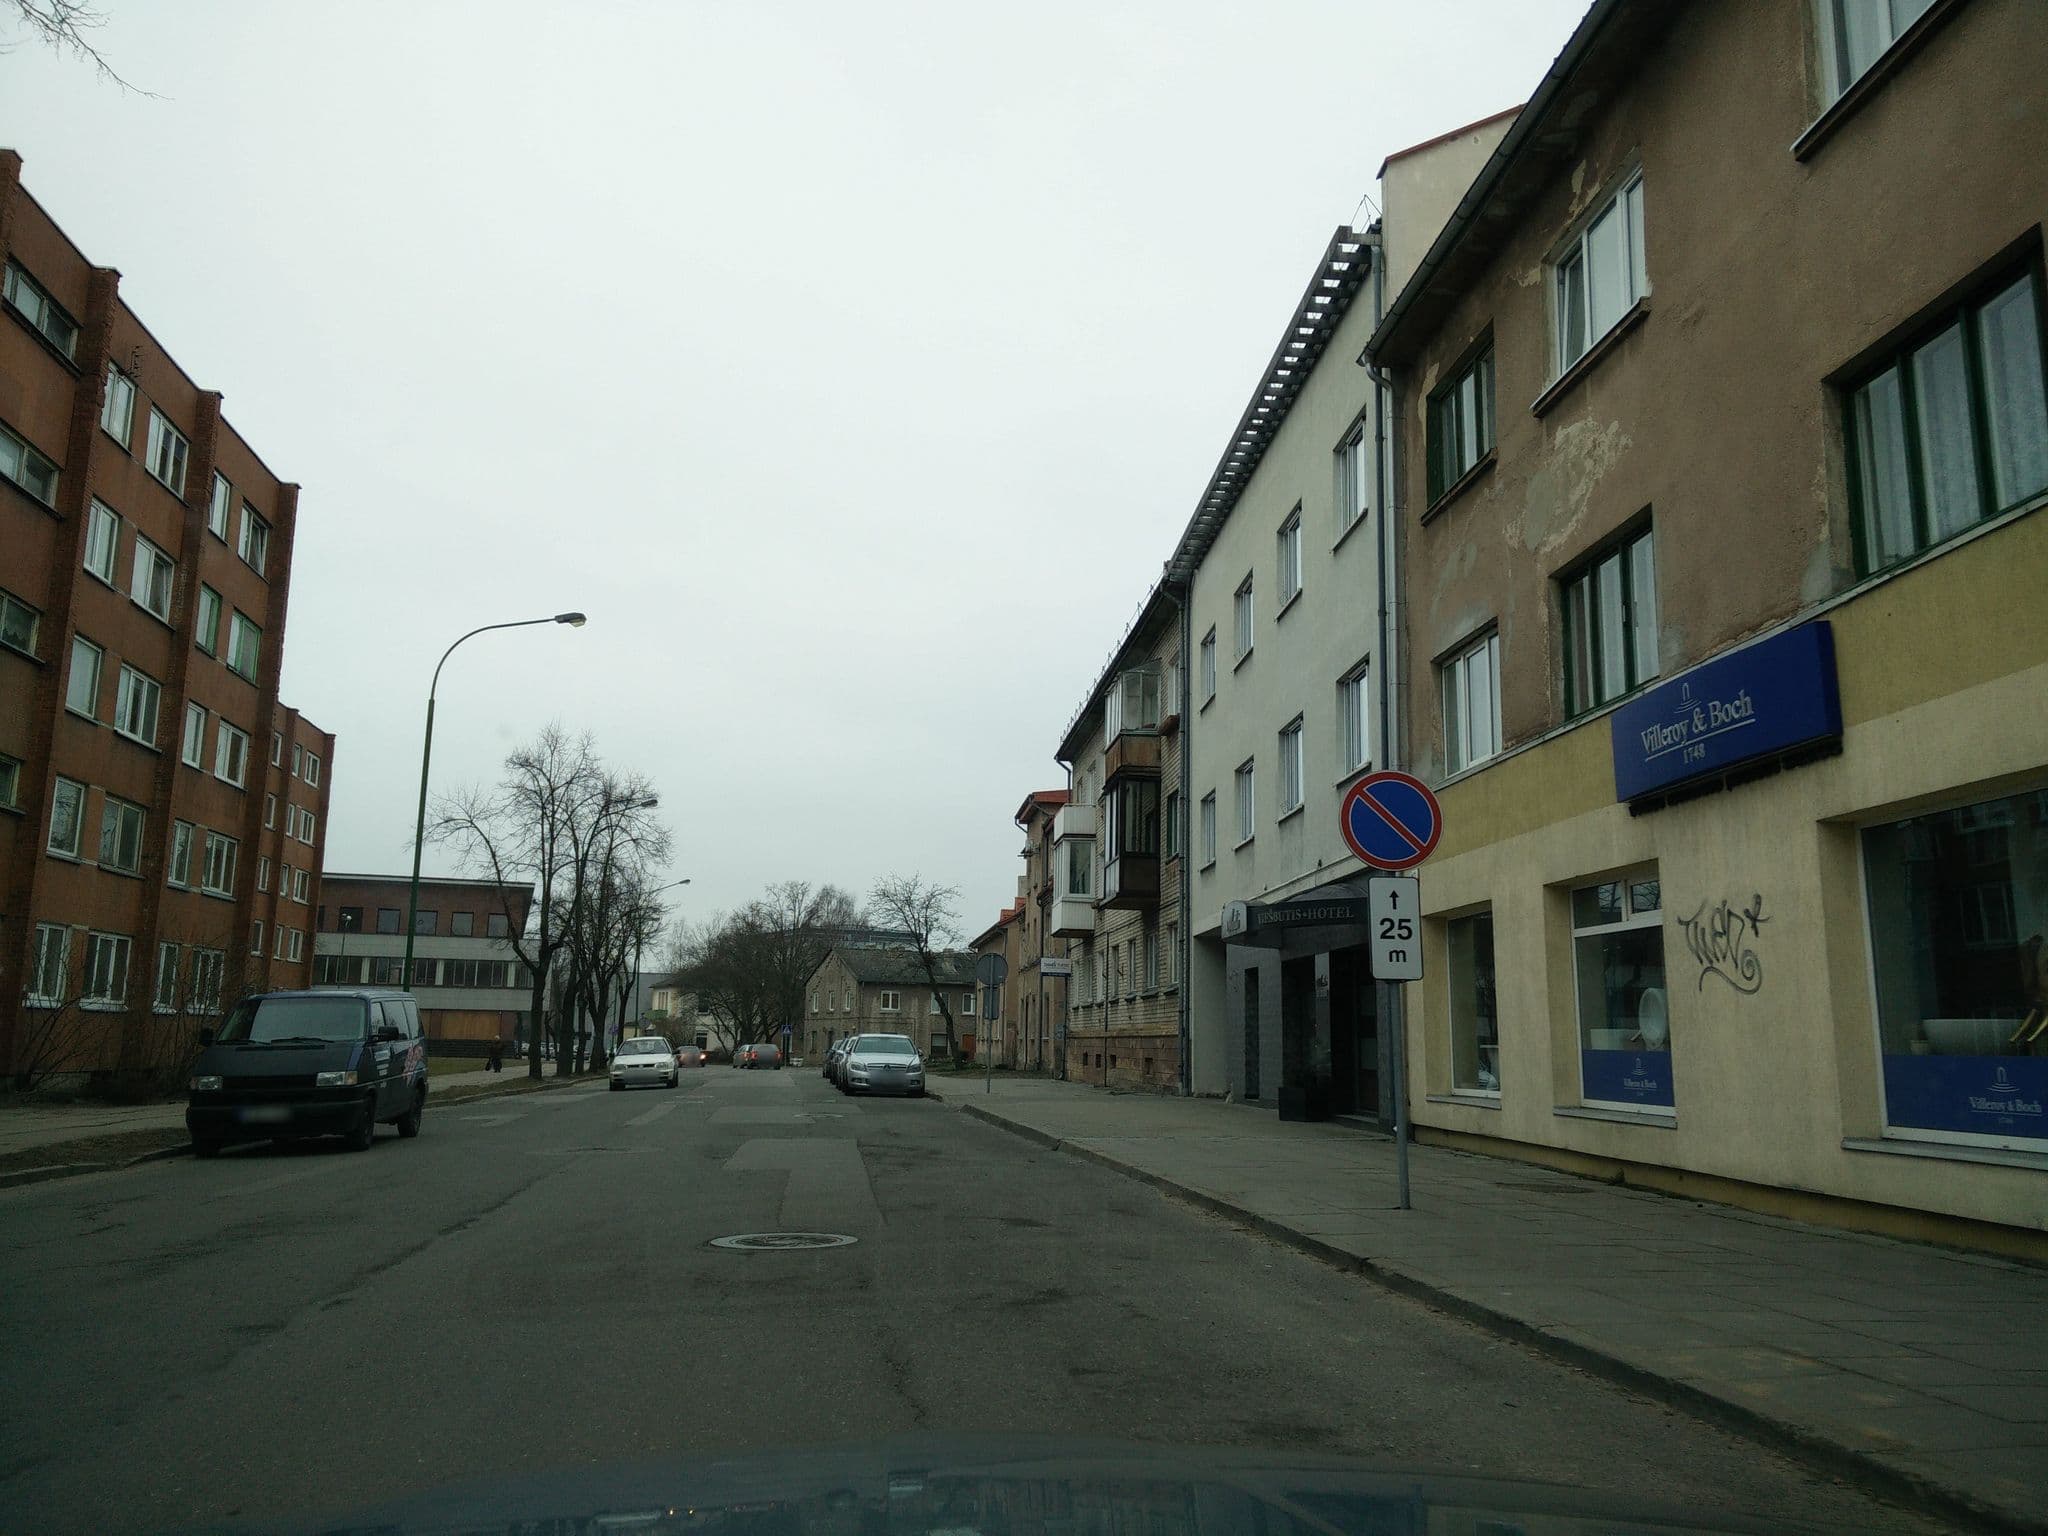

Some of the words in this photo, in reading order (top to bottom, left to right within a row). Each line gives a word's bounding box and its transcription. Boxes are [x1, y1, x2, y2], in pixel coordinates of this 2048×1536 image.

[1641, 718, 1689, 754] Villeroy
[1692, 708, 1708, 734] &
[1709, 689, 1754, 729] Boch
[1683, 744, 1706, 765] 1748
[1308, 906, 1355, 920] HOTEL
[1379, 917, 1413, 941] 25
[1389, 949, 1407, 963] m
